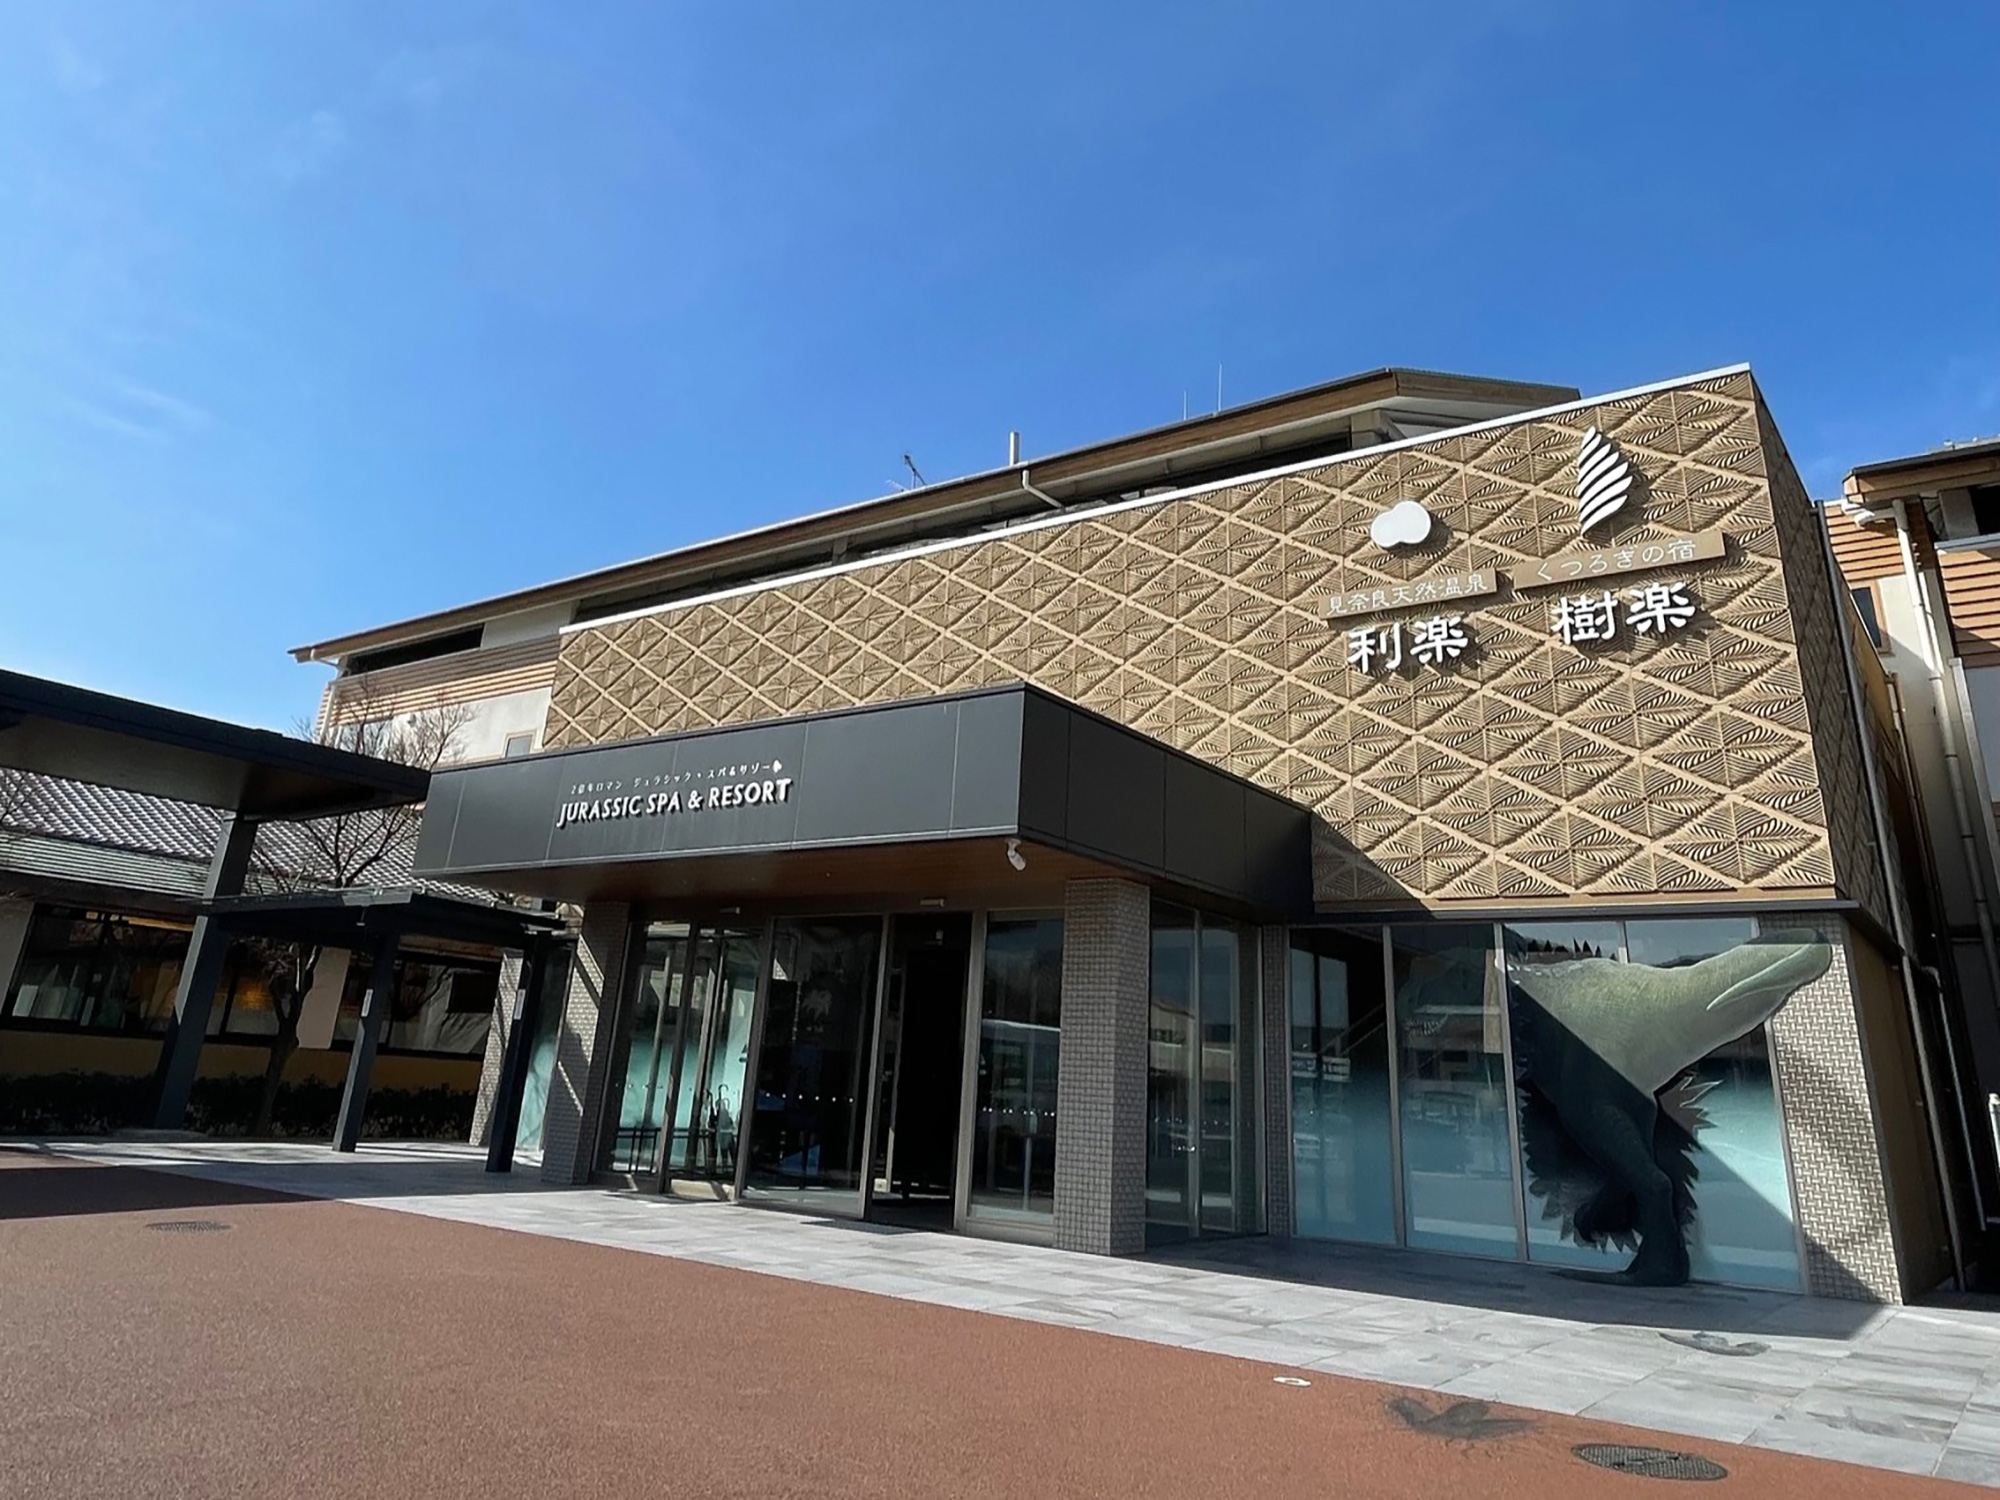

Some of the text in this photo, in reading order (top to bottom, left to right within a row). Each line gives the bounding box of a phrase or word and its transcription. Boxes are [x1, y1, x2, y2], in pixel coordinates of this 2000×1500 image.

[1537, 538, 1696, 581] くつろぎの宿
[1326, 573, 1488, 616] 見奈良天然温泉
[1551, 581, 1696, 645] 樹楽
[1347, 615, 1469, 674] 利楽
[556, 778, 792, 828] JURASSIC SPA & RESORT
